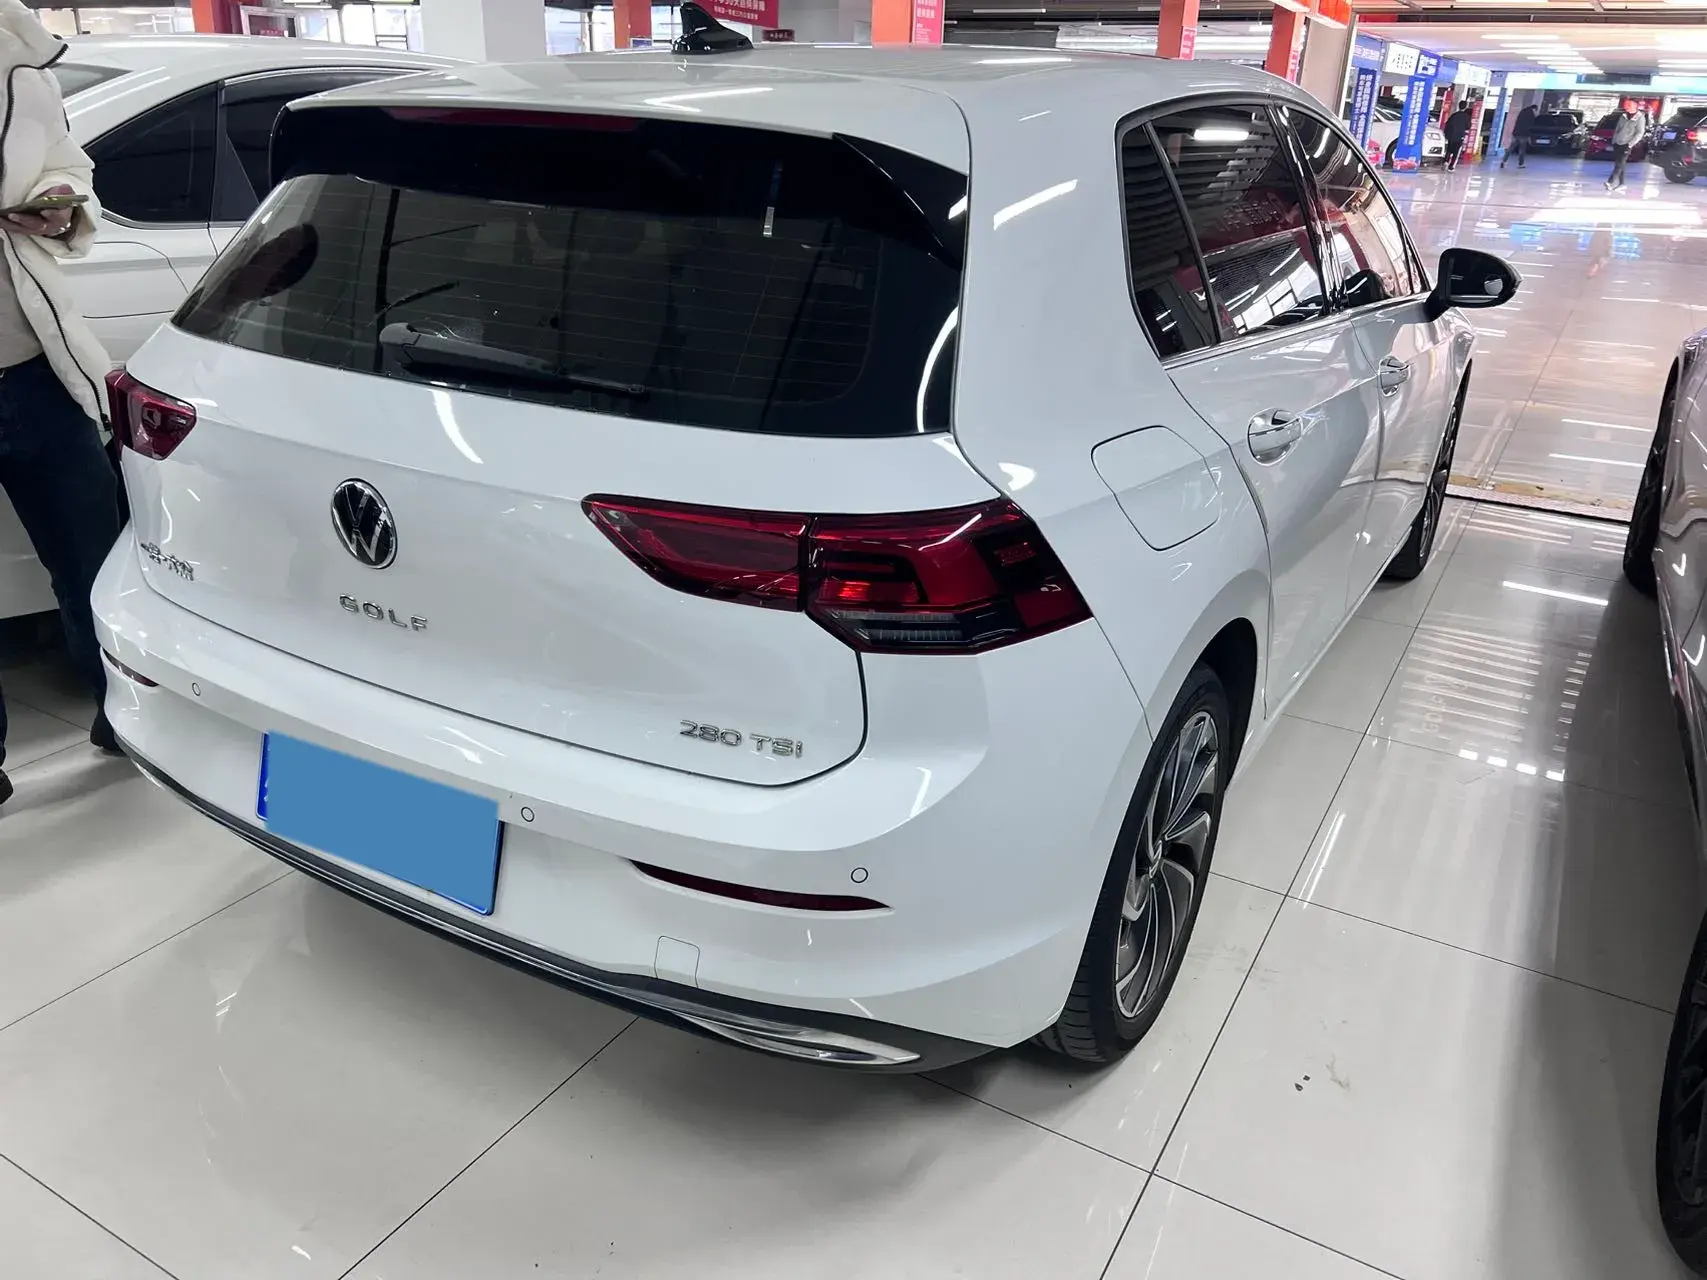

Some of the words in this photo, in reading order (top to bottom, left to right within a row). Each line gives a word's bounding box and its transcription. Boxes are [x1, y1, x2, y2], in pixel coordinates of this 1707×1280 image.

[339, 593, 428, 632] GOLF
[680, 719, 742, 746] 280
[749, 733, 803, 758] TSI
